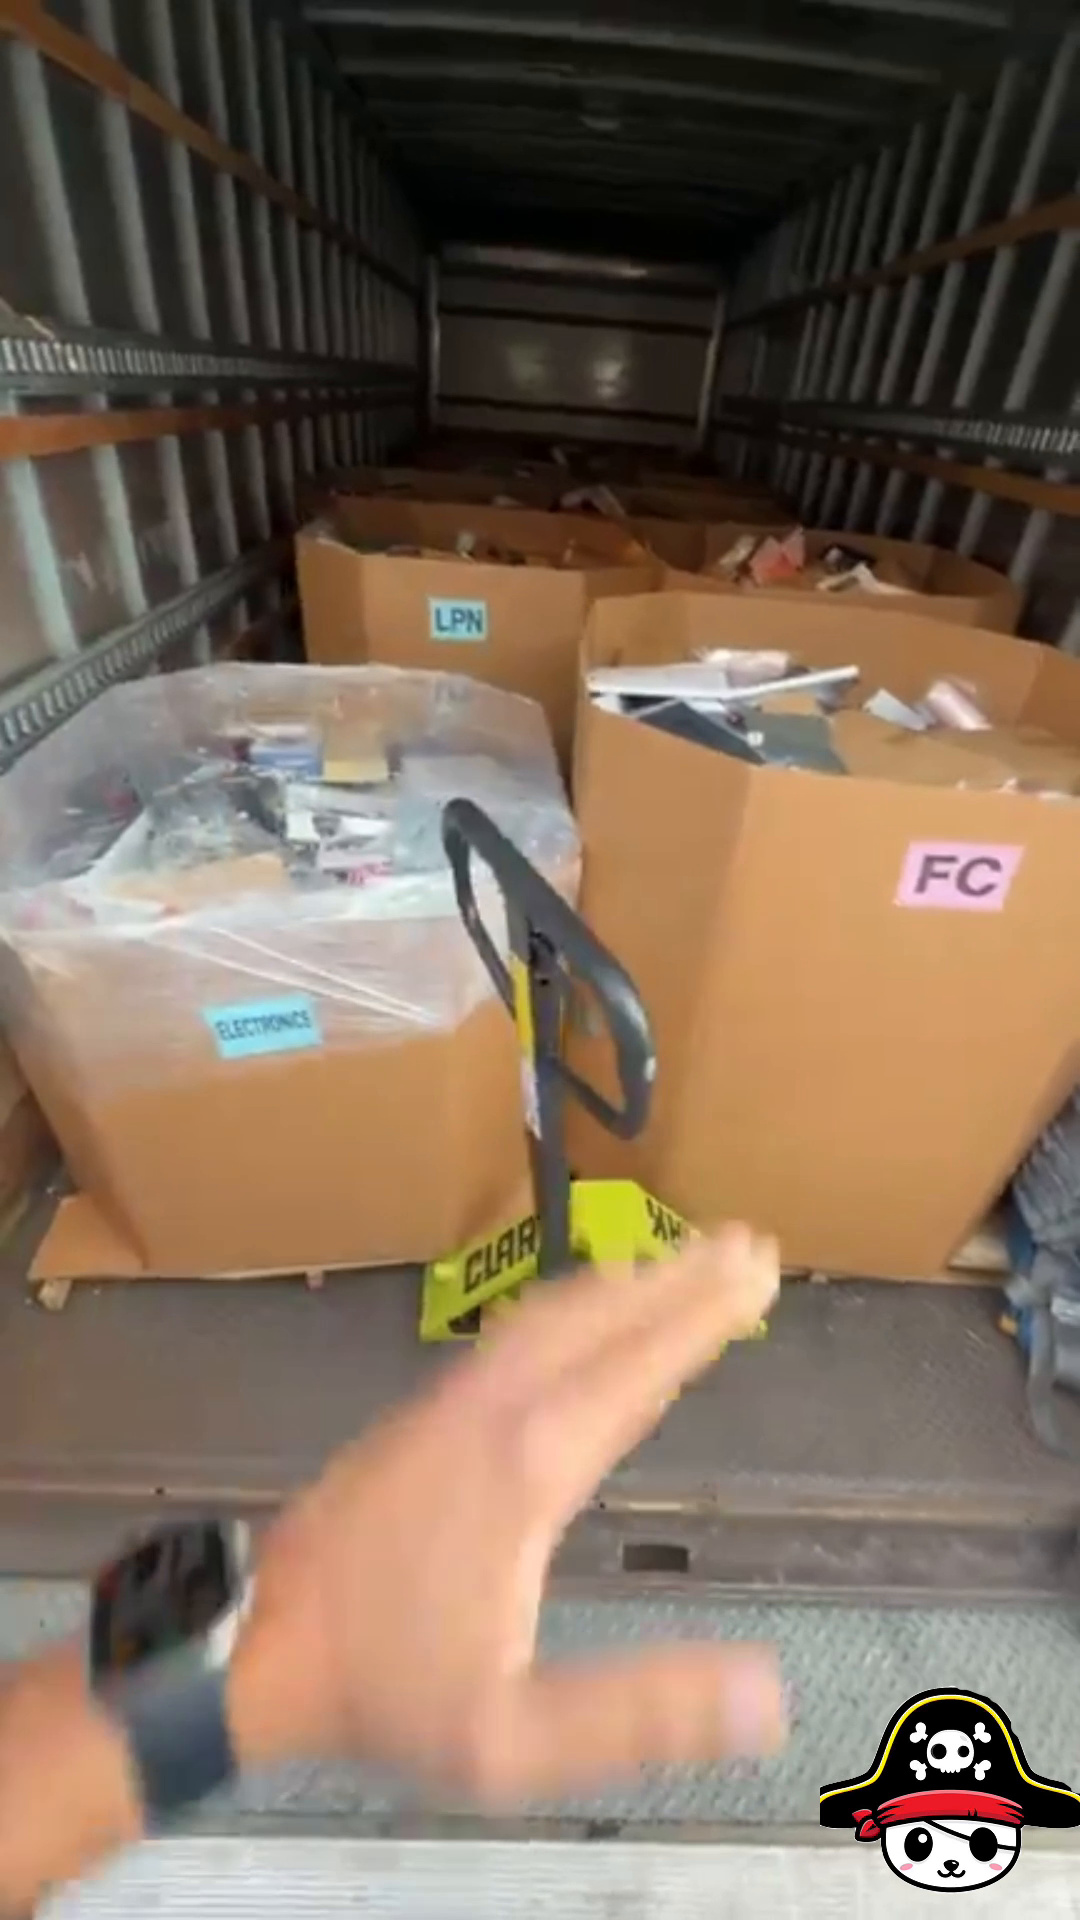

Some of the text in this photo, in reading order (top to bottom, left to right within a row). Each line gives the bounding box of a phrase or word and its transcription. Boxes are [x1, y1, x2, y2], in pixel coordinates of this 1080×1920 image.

[435, 607, 483, 633] LPN
[914, 854, 1003, 898] FC
[215, 1009, 312, 1041] ELECTRONICS
[464, 1215, 541, 1294] CLAR
